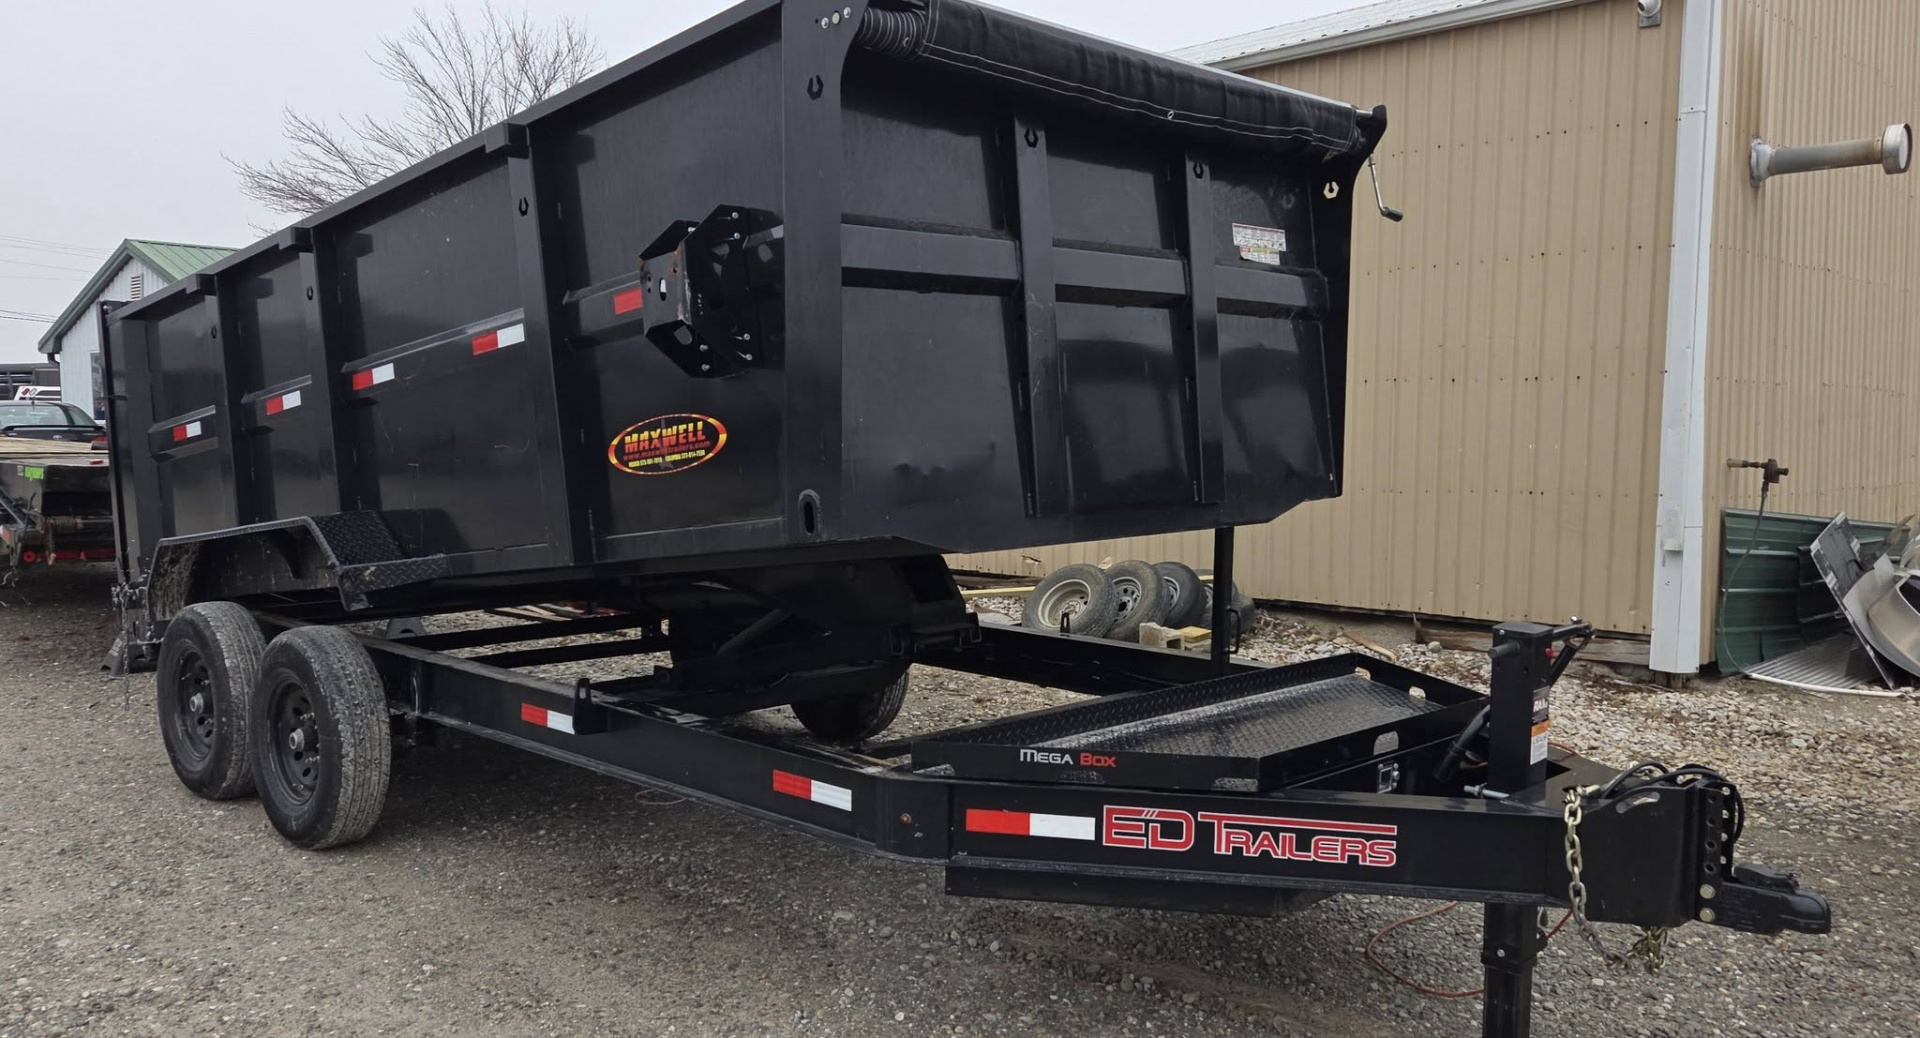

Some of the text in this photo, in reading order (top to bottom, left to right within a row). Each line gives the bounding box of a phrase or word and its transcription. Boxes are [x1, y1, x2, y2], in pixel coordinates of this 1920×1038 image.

[624, 421, 706, 453] MAXWELL
[1020, 749, 1074, 765] MEGA
[1103, 805, 1397, 868] ED TRAILERS
